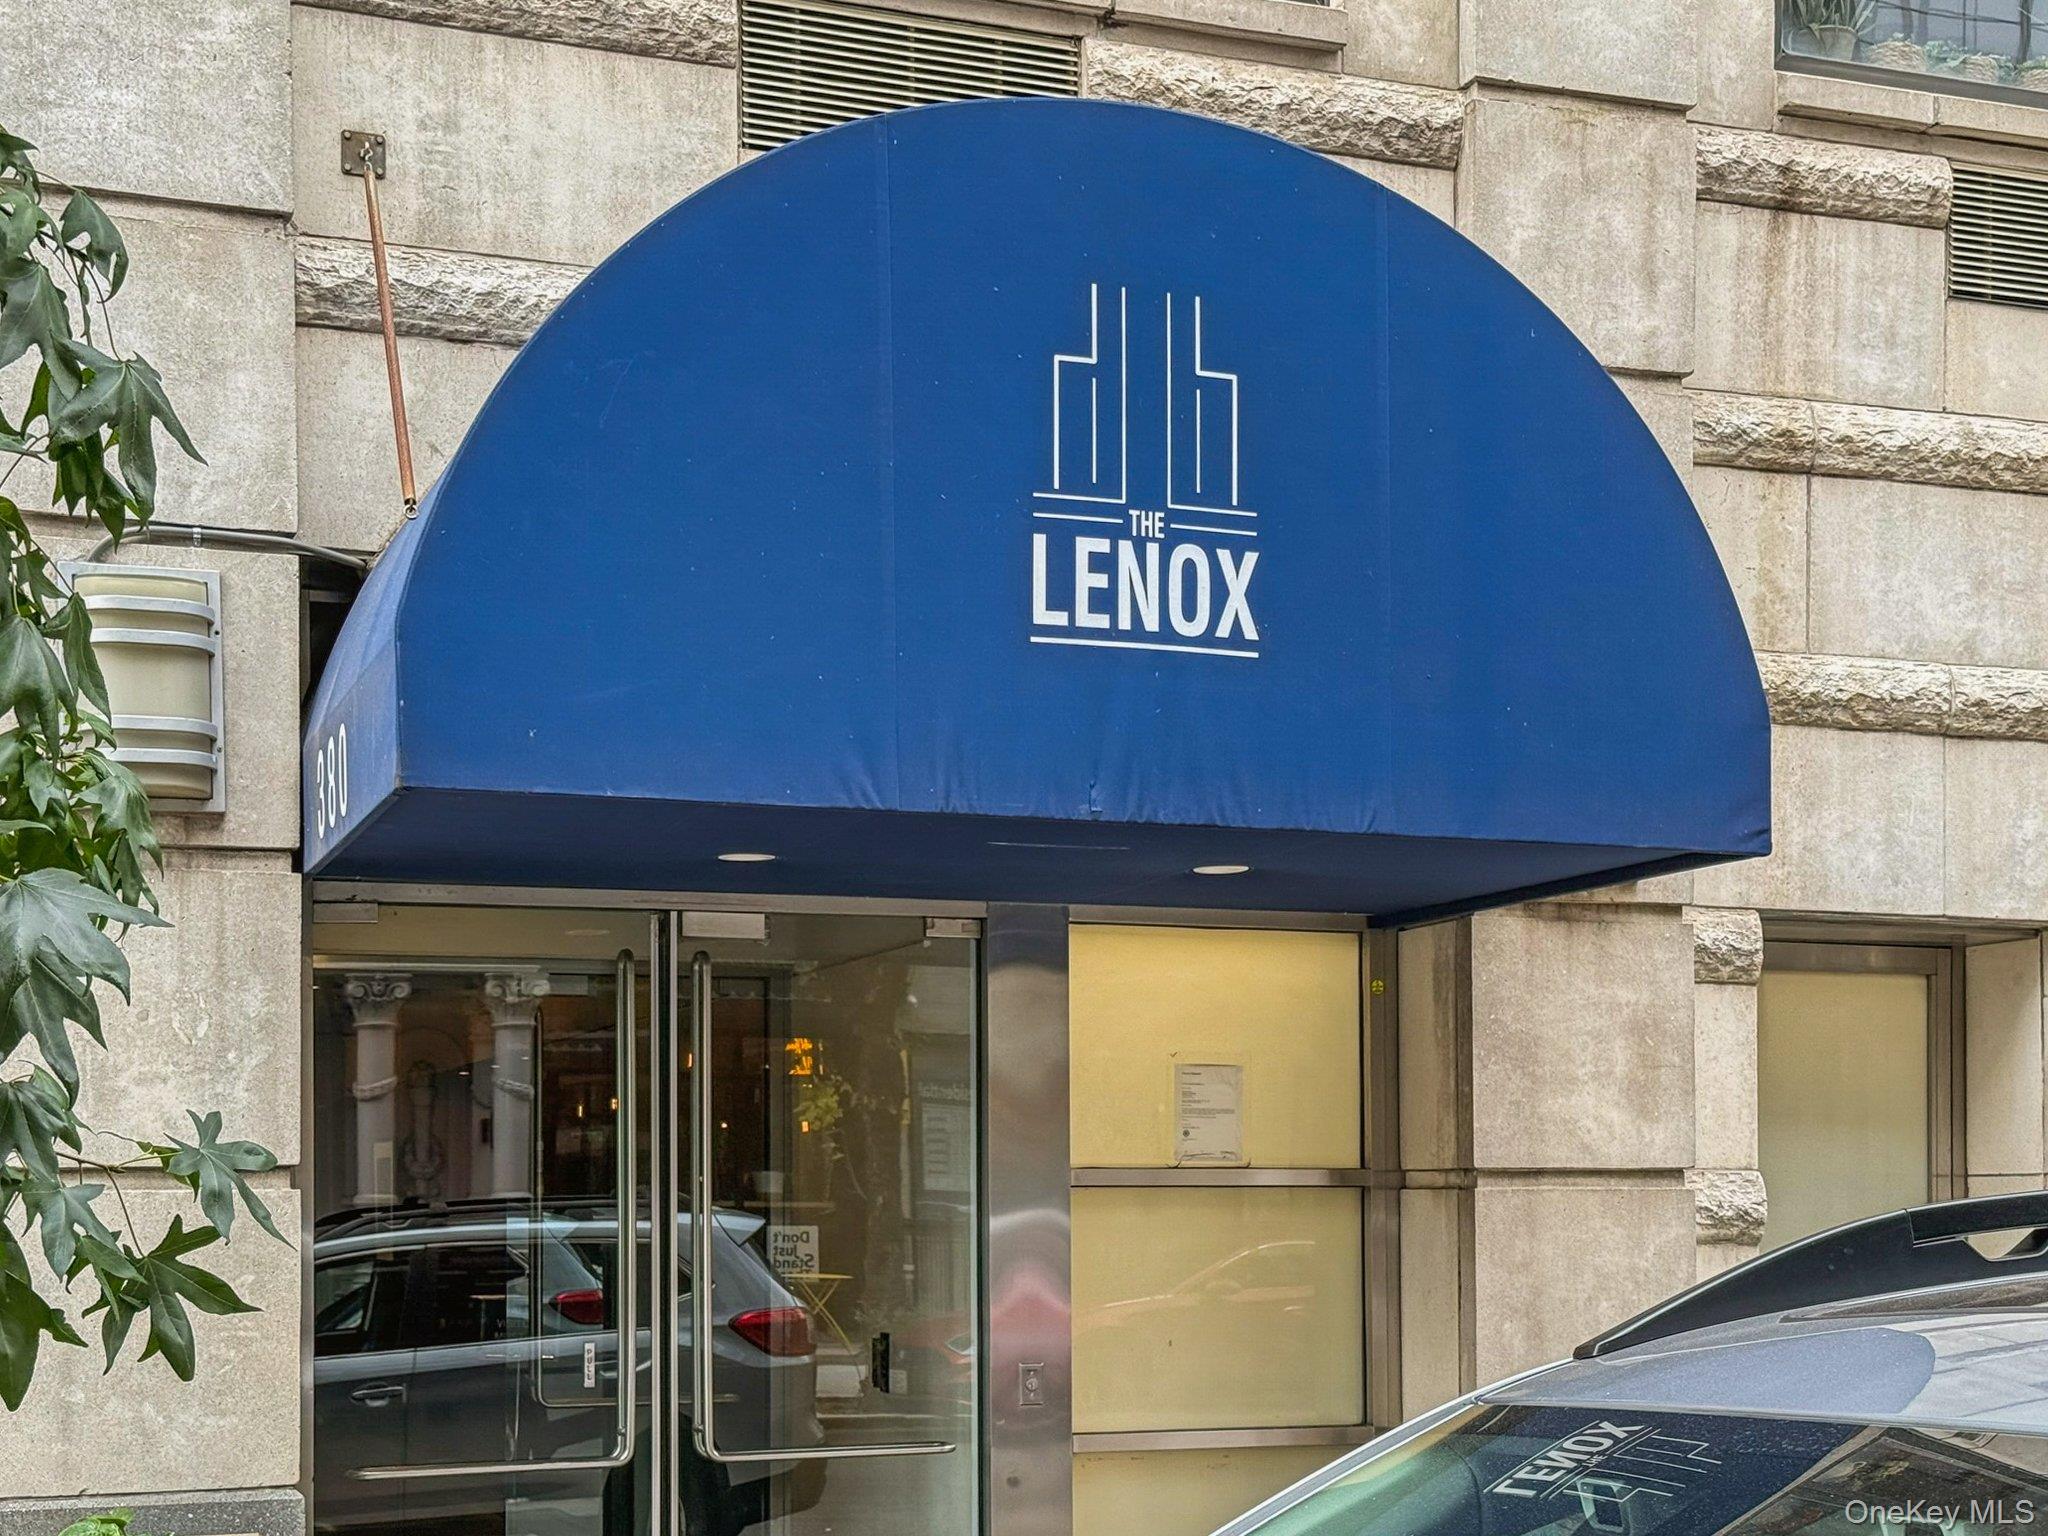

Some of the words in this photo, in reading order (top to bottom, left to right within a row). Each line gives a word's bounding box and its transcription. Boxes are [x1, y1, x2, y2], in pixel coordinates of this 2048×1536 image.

[1128, 509, 1165, 538] THE
[1033, 533, 1260, 641] LENOX
[316, 722, 347, 839] 380
